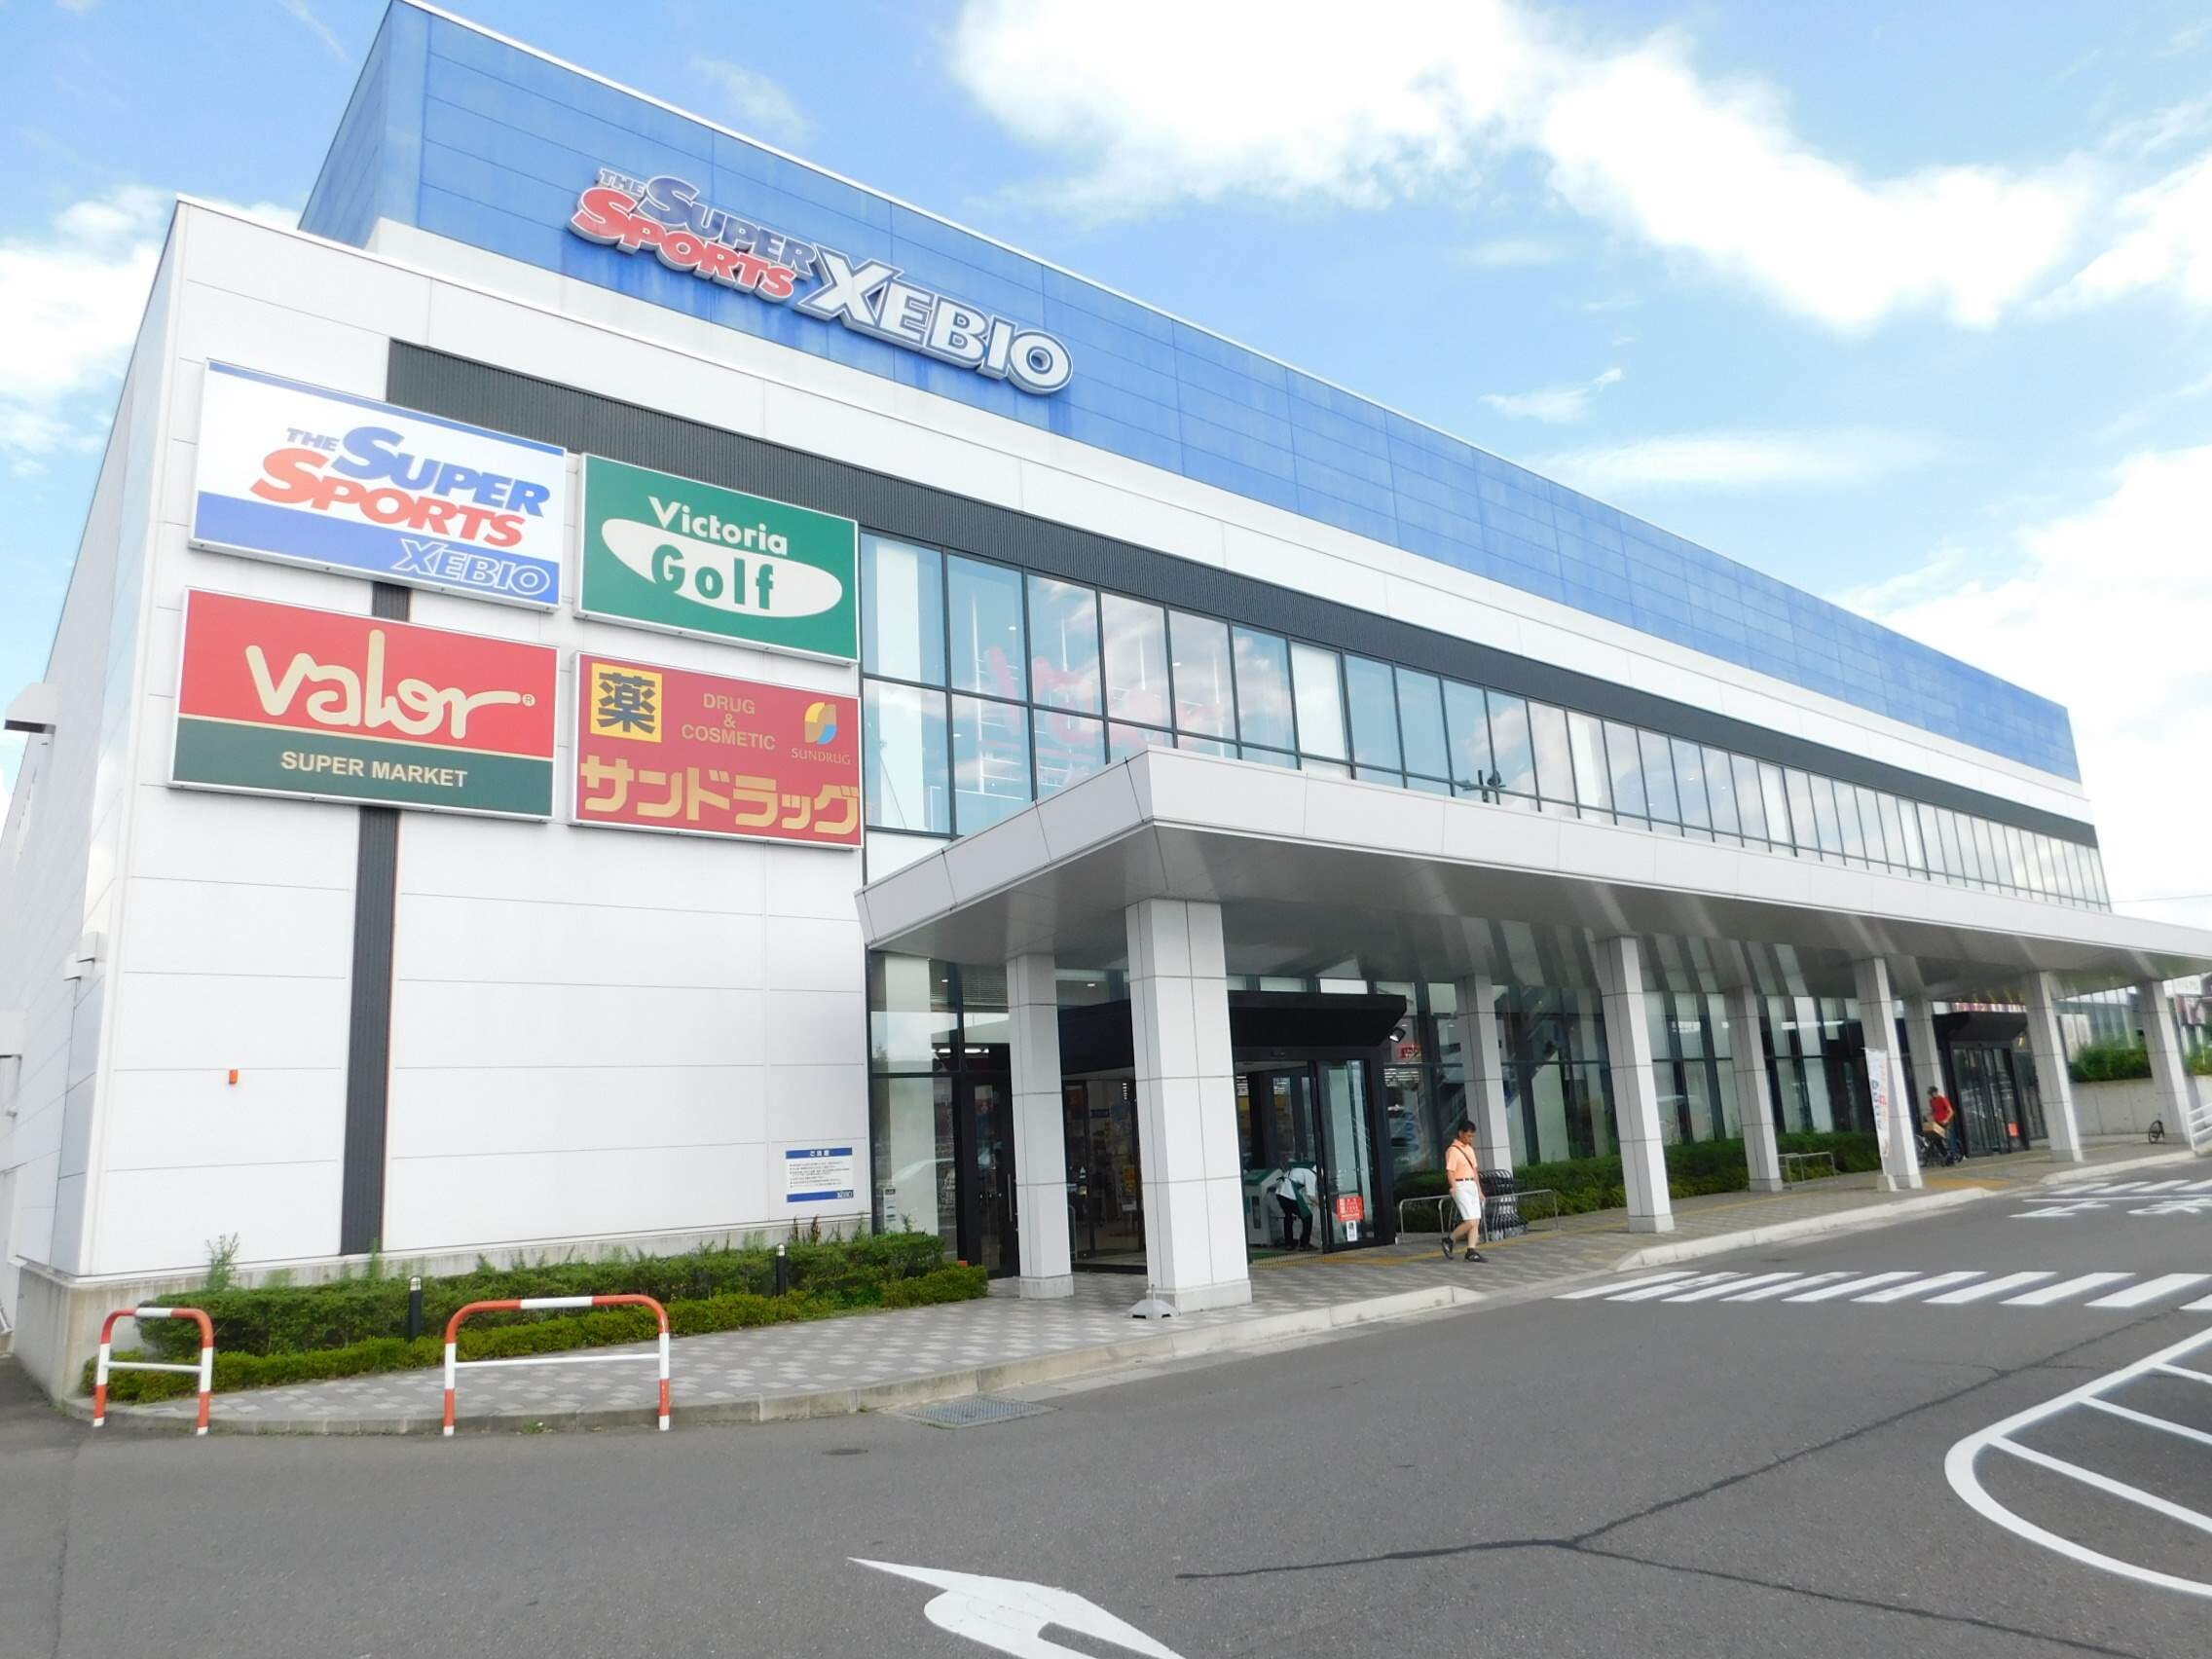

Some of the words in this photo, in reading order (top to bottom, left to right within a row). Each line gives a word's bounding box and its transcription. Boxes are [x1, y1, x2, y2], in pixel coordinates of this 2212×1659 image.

[569, 186, 795, 301] SPORTS
[597, 166, 645, 198] THE
[638, 175, 816, 282] SUPER
[793, 242, 1072, 394] XEBIO
[249, 447, 526, 547] SPORTS
[286, 426, 340, 452] THE
[330, 426, 551, 518] SUPER
[647, 495, 788, 556] Victoria
[391, 538, 551, 596] XEBIO
[651, 543, 774, 610] Golf
[596, 672, 656, 735] 薬
[703, 692, 756, 715] DRUG
[723, 713, 736, 729] &
[682, 723, 776, 751] COSMETIC
[791, 747, 851, 765] SUNDRUG
[280, 751, 364, 777] SUPER
[372, 760, 467, 789] MARKET
[579, 755, 860, 835] サンドラッグ
